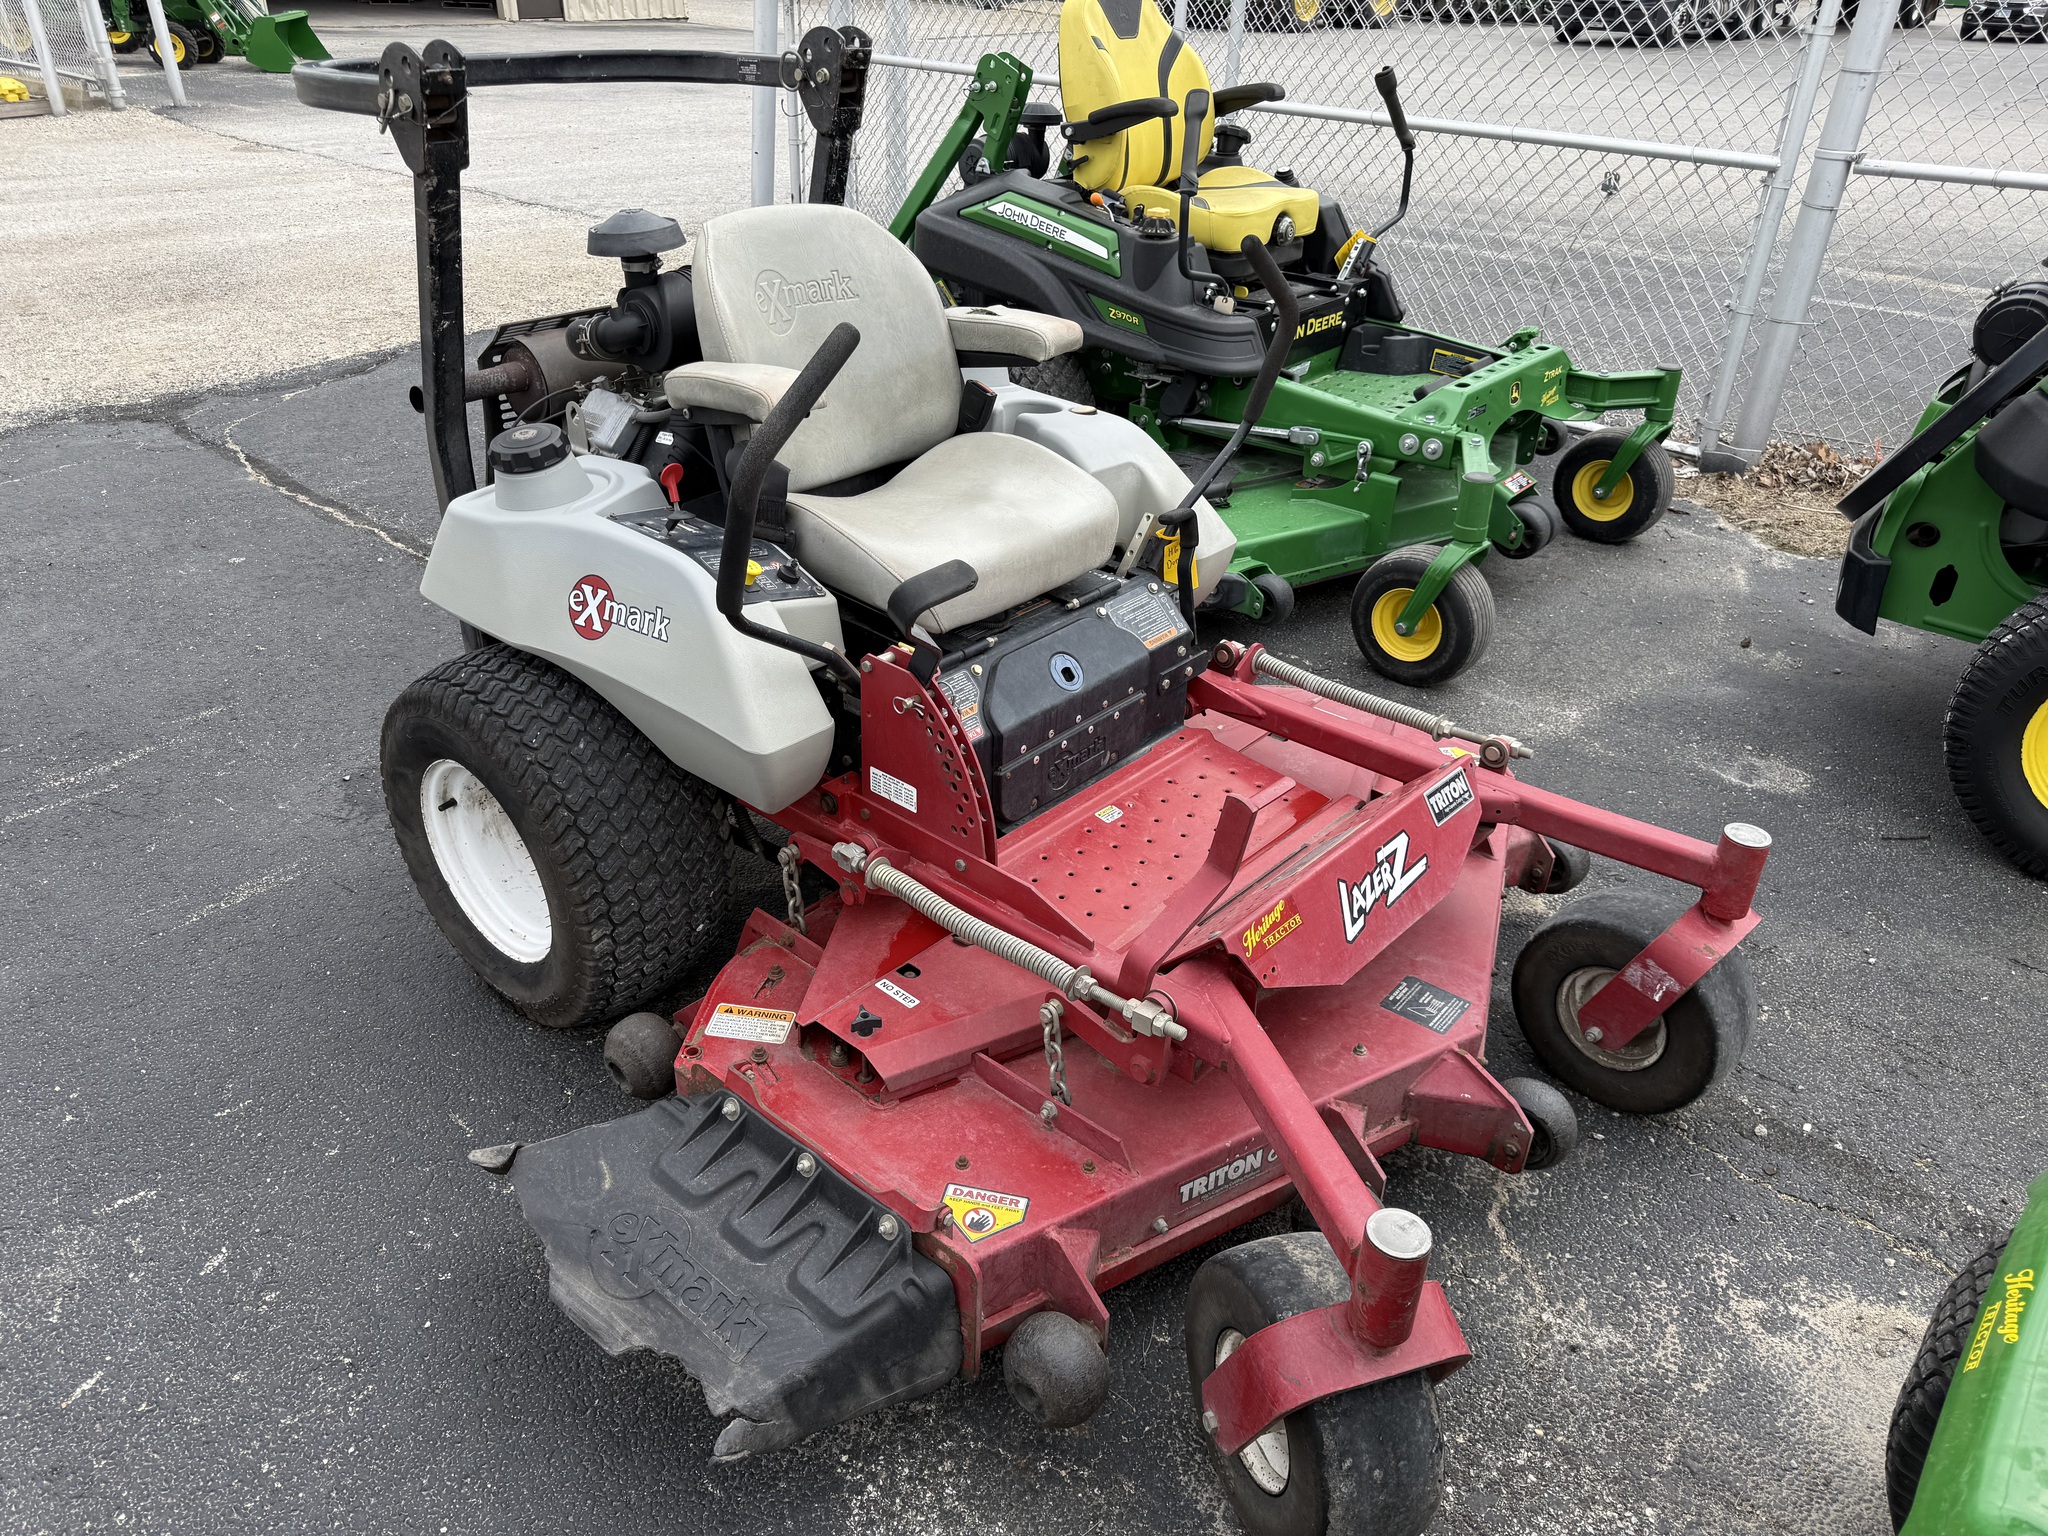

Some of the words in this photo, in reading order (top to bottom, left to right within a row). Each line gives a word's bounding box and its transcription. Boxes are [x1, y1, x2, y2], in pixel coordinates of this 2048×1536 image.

[998, 204, 1029, 226] JOHN
[1030, 214, 1067, 240] DEERE
[1108, 307, 1140, 325] Z970R
[1306, 311, 1344, 336] DEERE
[568, 582, 671, 643] eXmark
[1429, 774, 1468, 814] TRITON
[1242, 899, 1286, 958] Heritage
[1263, 914, 1302, 948] TRACTOR
[880, 981, 894, 991] NO
[893, 990, 916, 1004] STEP
[737, 1009, 787, 1020] WARNING
[1179, 1148, 1264, 1203] TRITON
[952, 1187, 1021, 1207] DANGER
[1997, 1269, 2034, 1344] Heritage
[1964, 1302, 2001, 1371] TRACTOR
